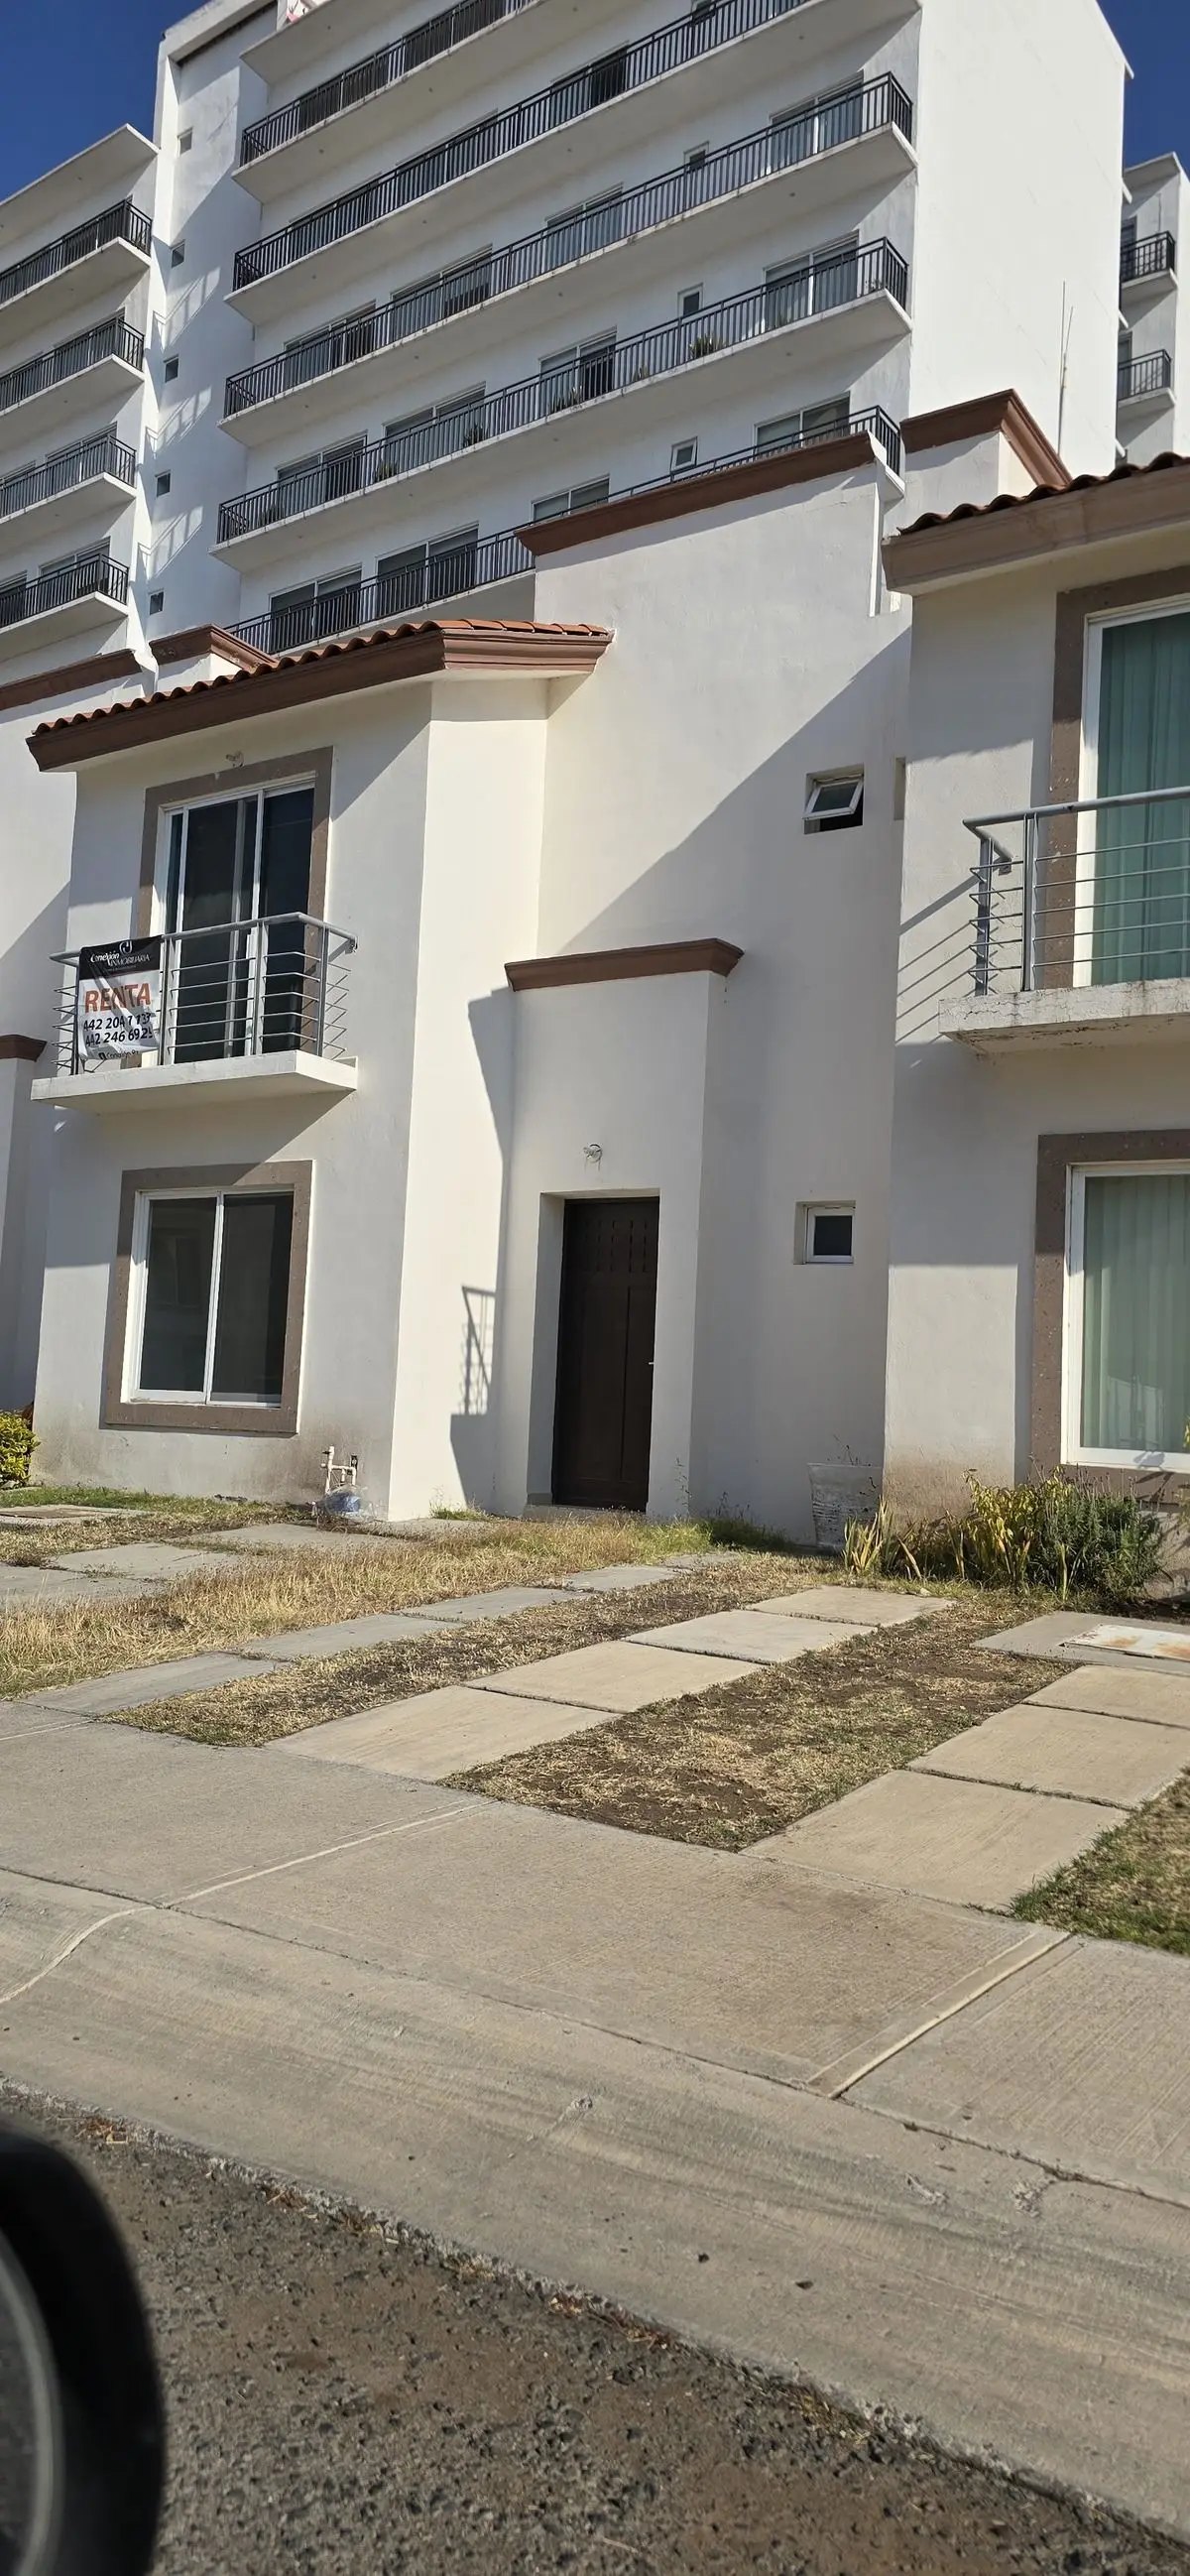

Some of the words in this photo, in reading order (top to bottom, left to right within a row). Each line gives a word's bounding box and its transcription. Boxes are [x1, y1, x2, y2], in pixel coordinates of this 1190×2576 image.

[84, 982, 151, 1013] RENTA
[83, 1019, 103, 1032] 442
[105, 1016, 125, 1029] 204
[85, 1032, 101, 1046] 442
[103, 1030, 126, 1043] 246
